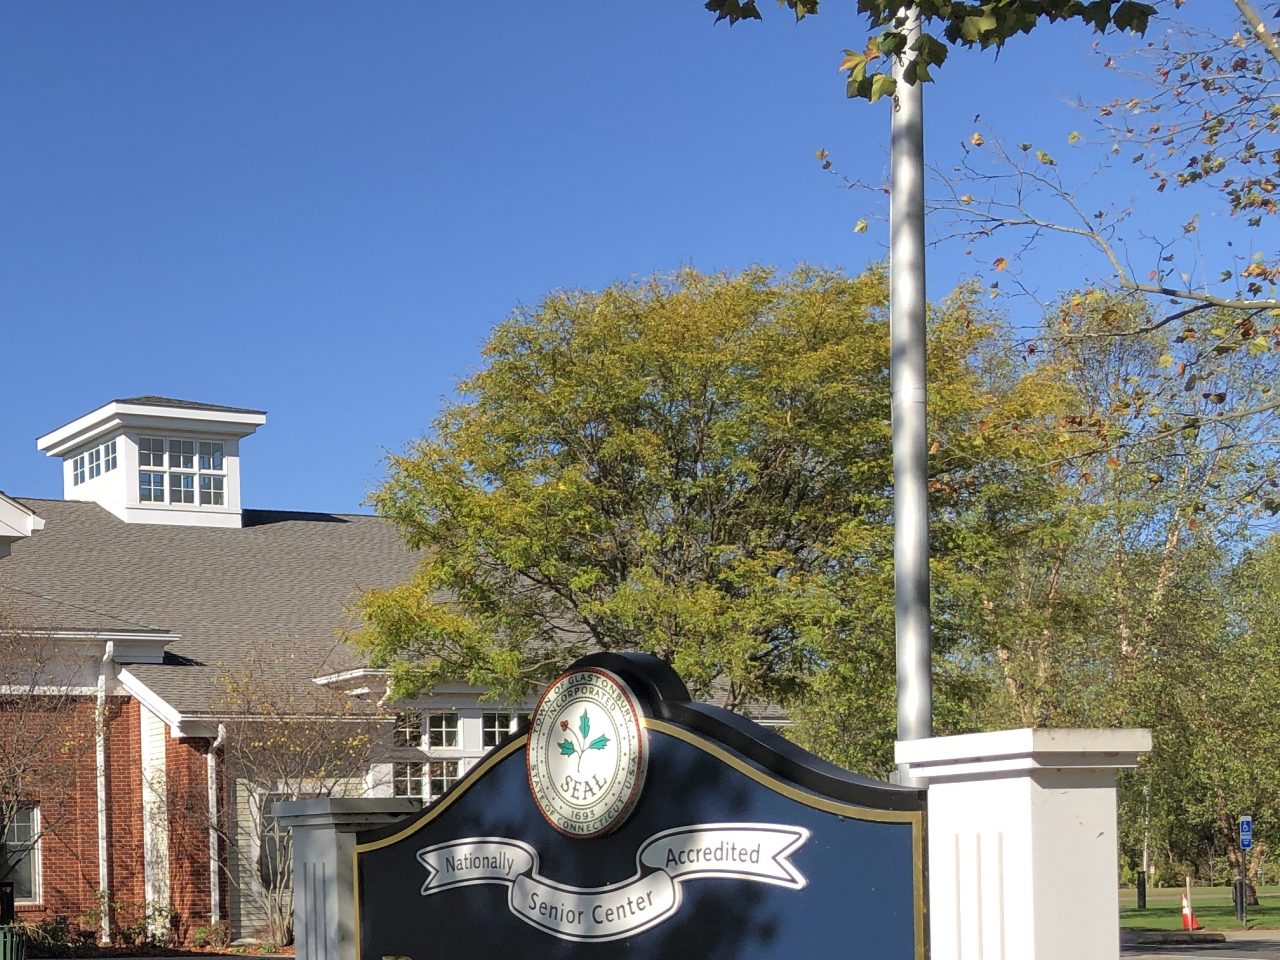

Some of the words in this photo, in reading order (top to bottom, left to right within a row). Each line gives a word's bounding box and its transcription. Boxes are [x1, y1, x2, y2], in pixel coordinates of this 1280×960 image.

[532, 697, 552, 734] TOWN
[553, 682, 566, 695] OF
[569, 674, 634, 724] GLASTONBURY
[548, 686, 617, 720] INCORPORATED
[530, 764, 546, 801] STATE
[544, 804, 556, 817] OF
[557, 798, 625, 833] CONNECTICUT
[560, 773, 608, 801] SEAL
[571, 810, 596, 821] 1693
[445, 855, 515, 875] Nationally
[665, 842, 761, 869] Accredited
[528, 892, 584, 926] Senior
[591, 887, 656, 926] Center
